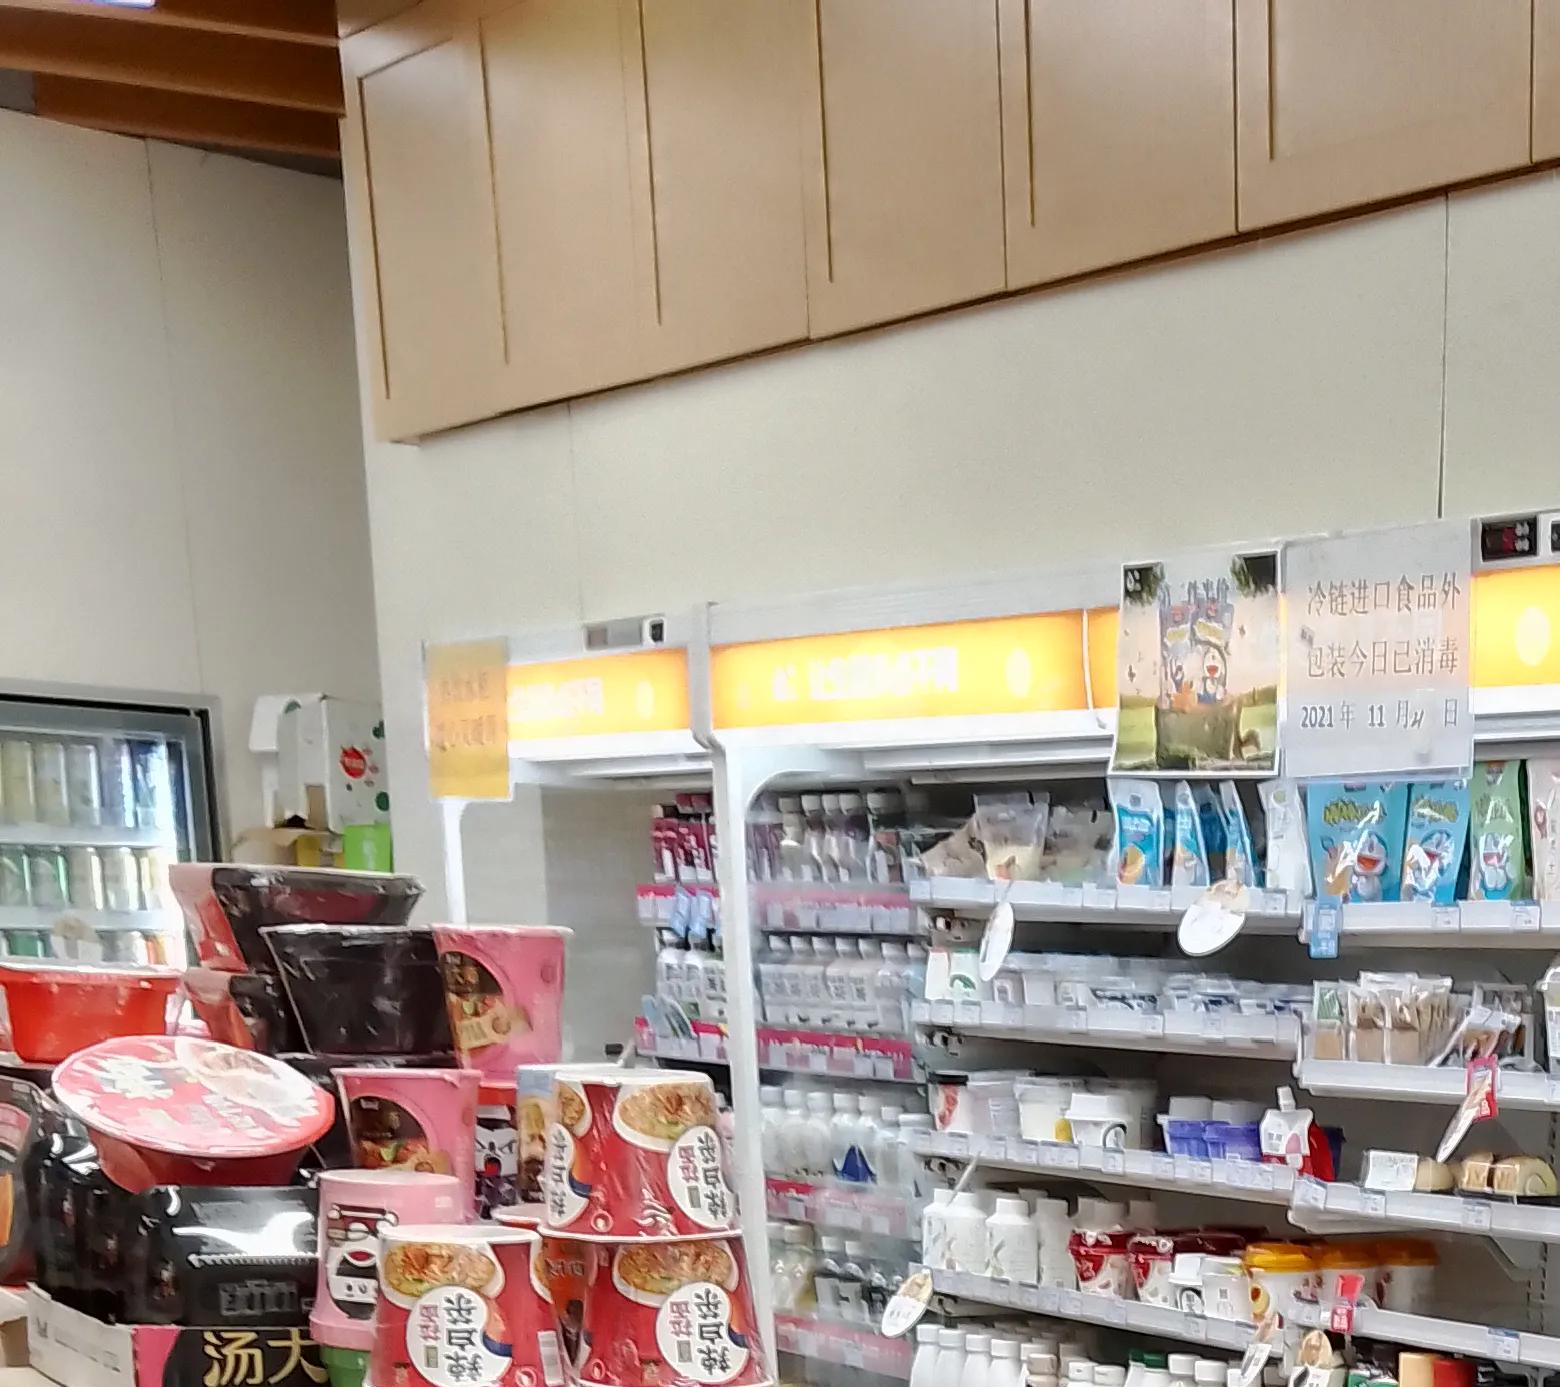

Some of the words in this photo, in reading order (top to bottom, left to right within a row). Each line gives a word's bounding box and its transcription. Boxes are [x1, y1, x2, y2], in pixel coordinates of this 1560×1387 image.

[1306, 570, 1462, 618] 冷链进口食品外
[1306, 637, 1460, 679] 包装今日已消毒
[444, 1293, 483, 1382] 辣白菜
[697, 1288, 731, 1376] 辣白菜
